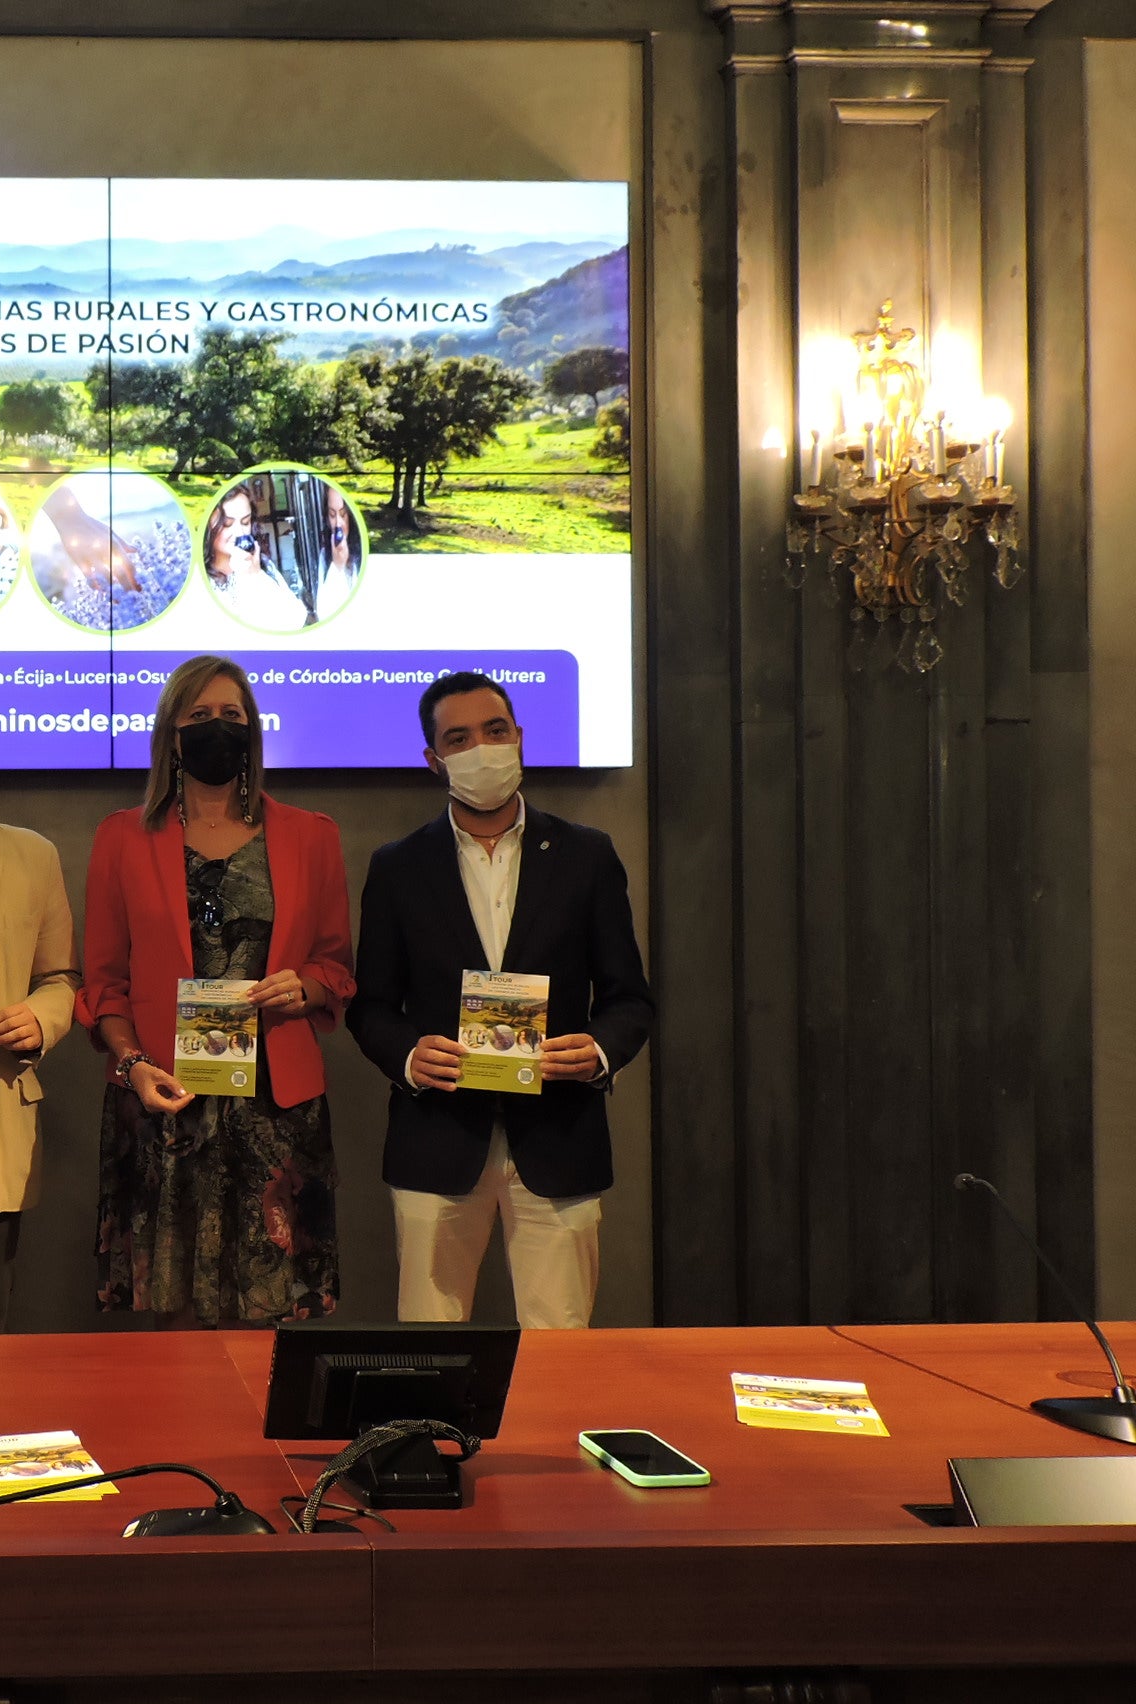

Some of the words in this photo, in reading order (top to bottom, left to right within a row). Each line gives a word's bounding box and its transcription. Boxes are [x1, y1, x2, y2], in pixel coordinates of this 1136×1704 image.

[54, 301, 190, 321] RURALES
[200, 301, 218, 321] Y
[228, 298, 488, 323] GASTRONÓMICAS
[28, 333, 67, 353] DE
[79, 327, 190, 354] PASIÓN
[262, 669, 285, 683] de
